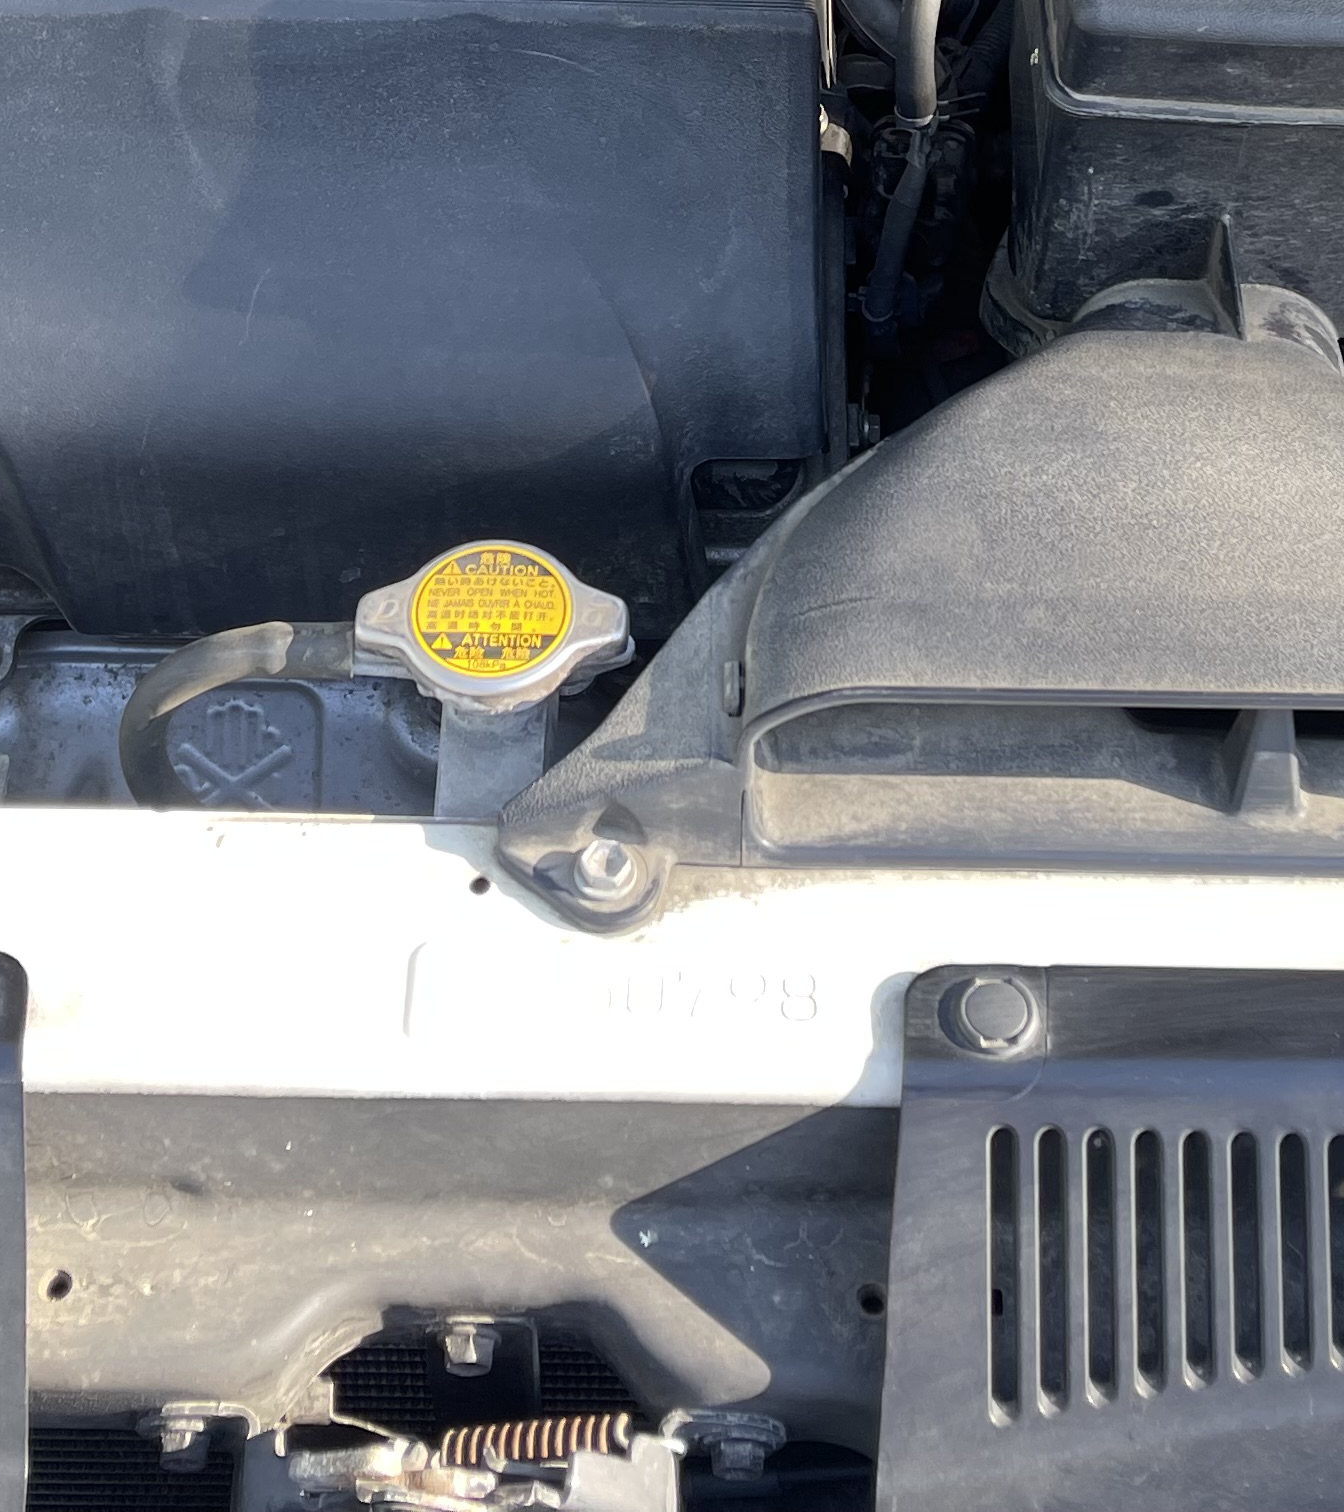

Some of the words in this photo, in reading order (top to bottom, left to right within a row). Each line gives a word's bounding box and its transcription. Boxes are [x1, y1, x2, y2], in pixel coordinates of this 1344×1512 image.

[464, 564, 539, 576] CAUTION
[428, 588, 461, 597] NEVER
[467, 588, 494, 597] OPEN
[500, 589, 528, 598] WHEN
[443, 599, 475, 607] JAMAIS
[461, 633, 542, 648] ATTENTION
